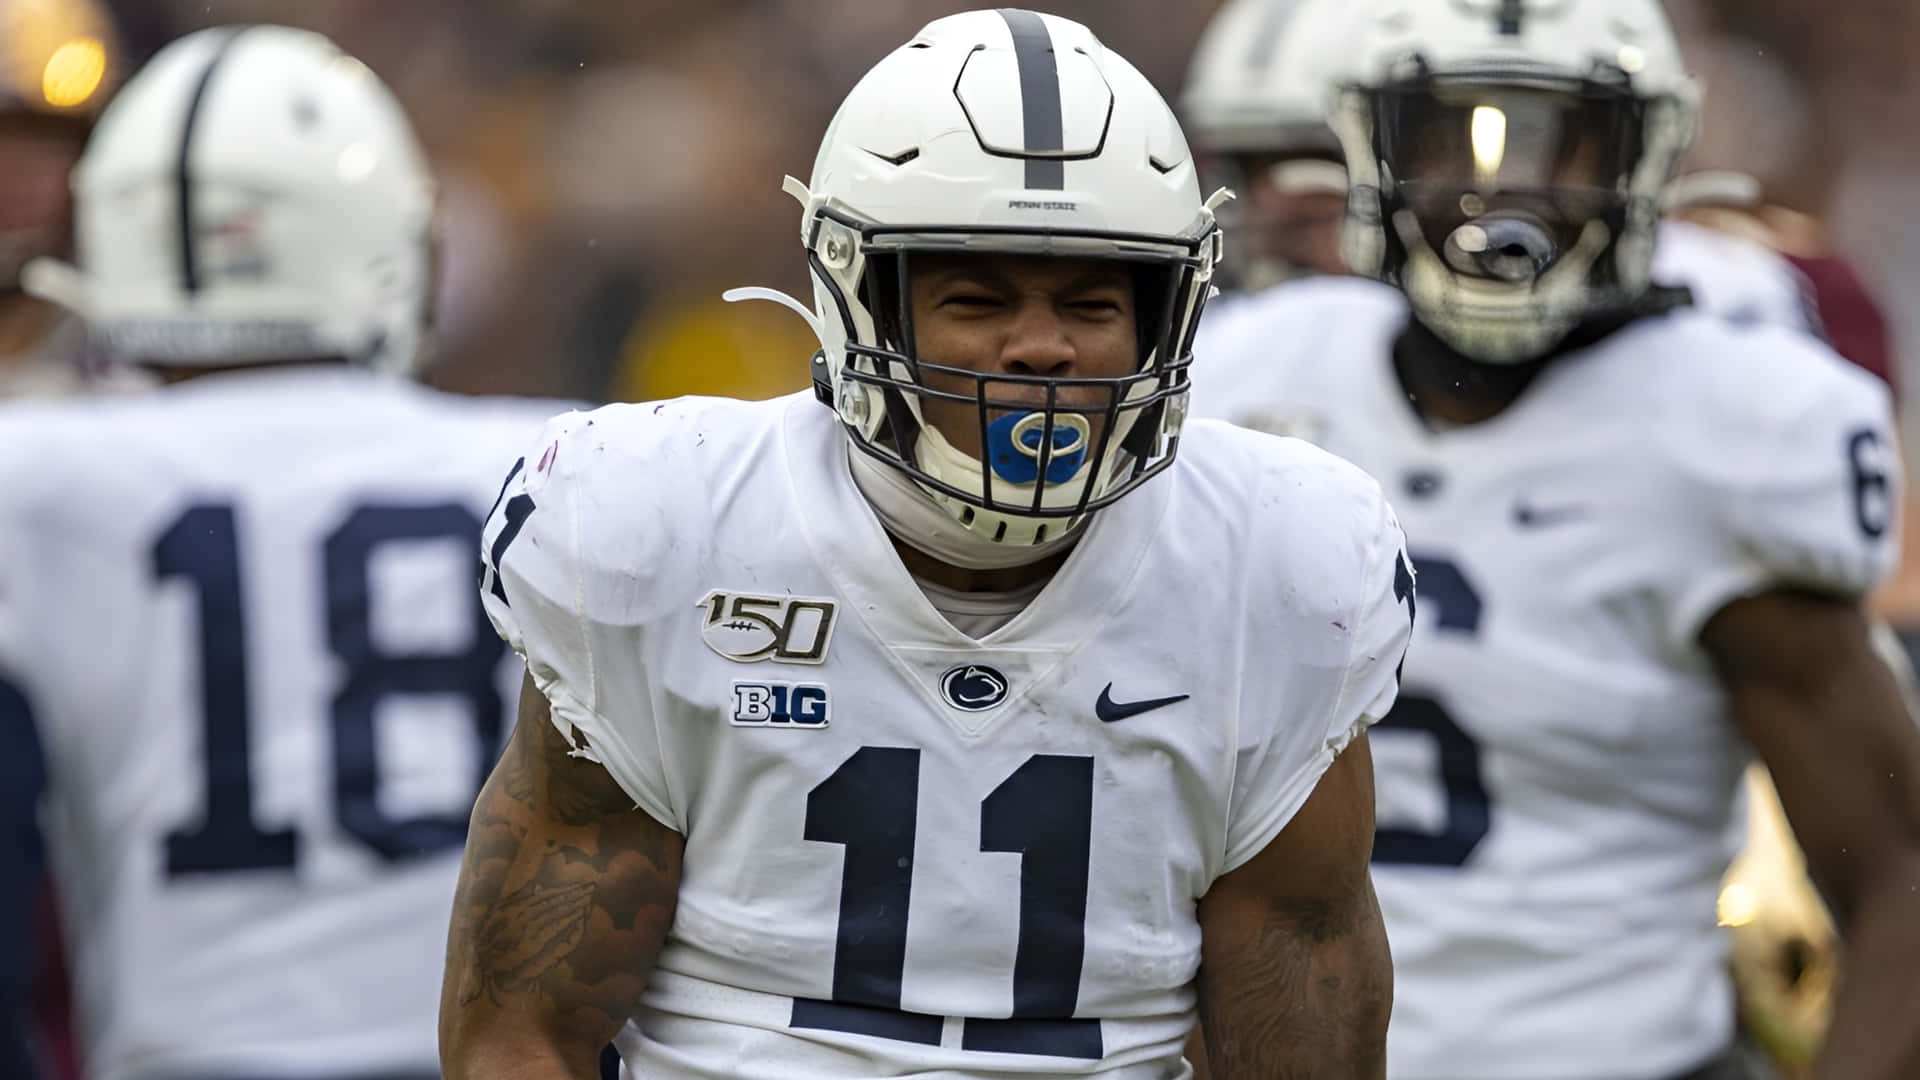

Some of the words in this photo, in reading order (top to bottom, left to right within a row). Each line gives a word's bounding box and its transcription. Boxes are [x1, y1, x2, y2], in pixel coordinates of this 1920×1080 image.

[1007, 200, 1040, 209] PENN
[1043, 201, 1077, 211] STATE
[1847, 430, 1890, 538] 6
[696, 593, 835, 659] 150
[150, 500, 508, 877] 18
[789, 746, 1104, 1060] 11
